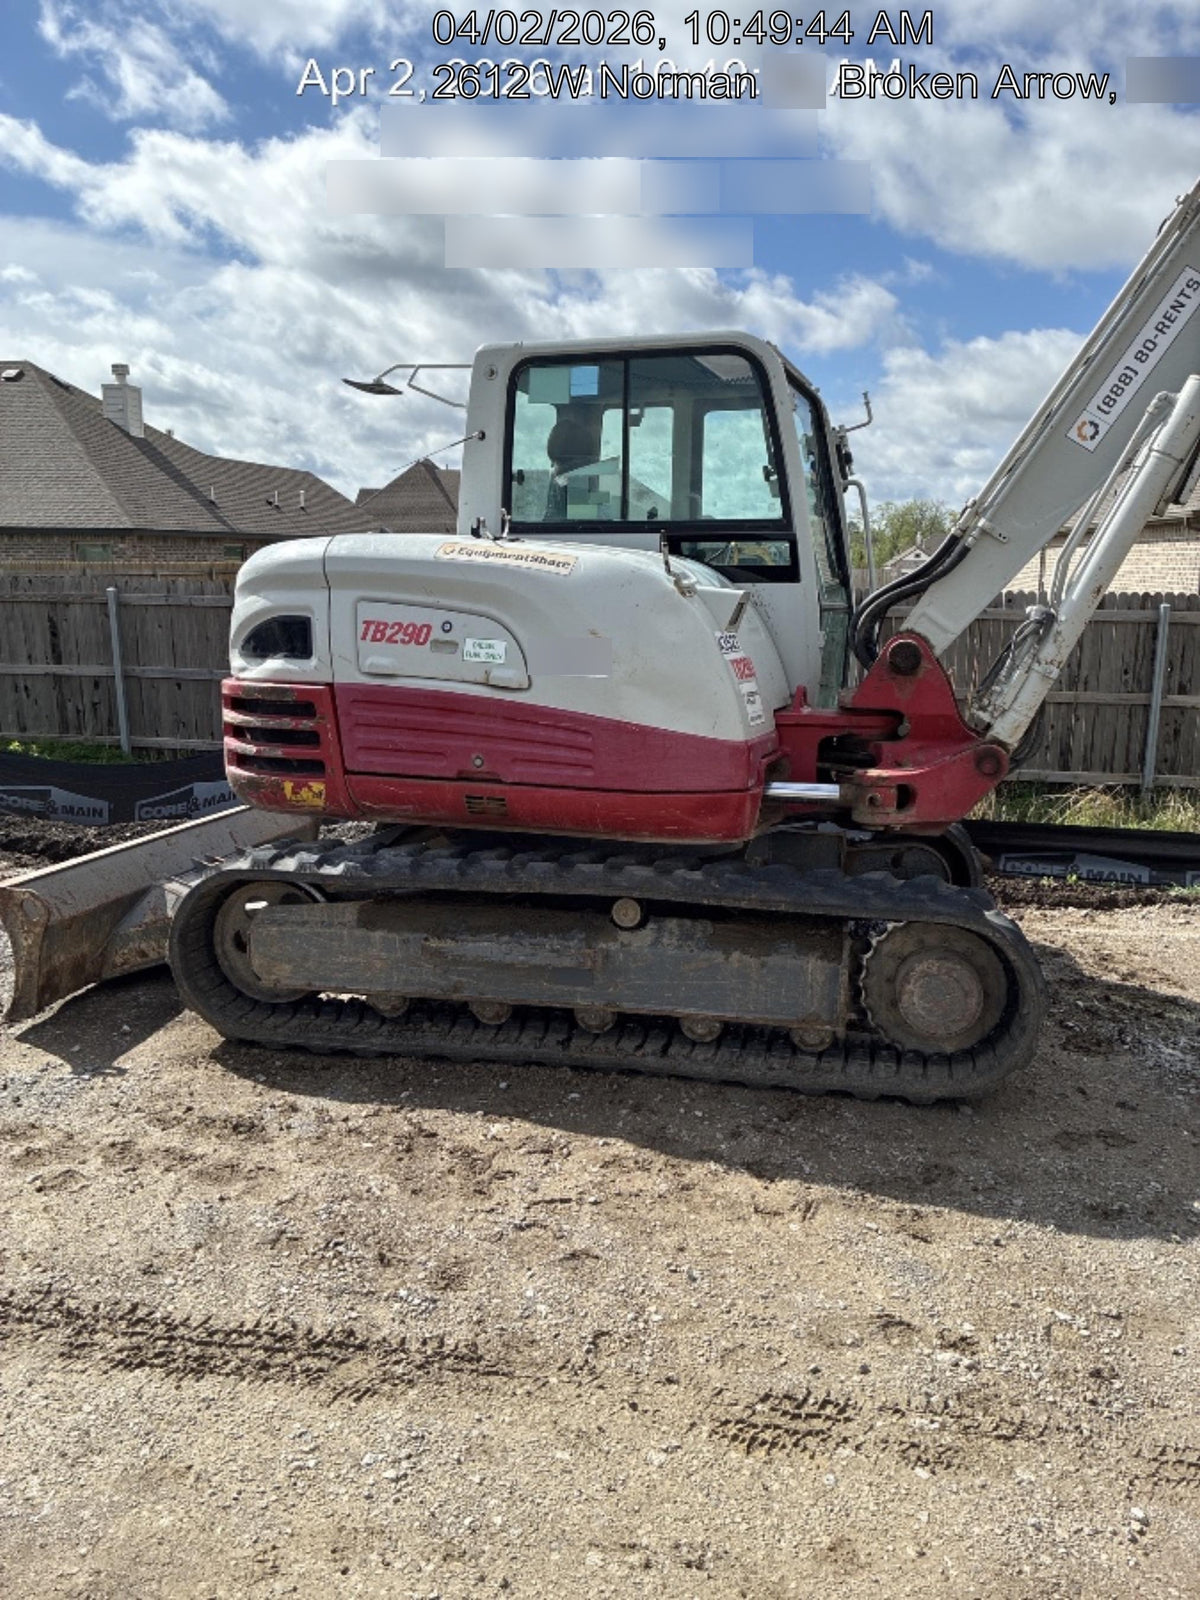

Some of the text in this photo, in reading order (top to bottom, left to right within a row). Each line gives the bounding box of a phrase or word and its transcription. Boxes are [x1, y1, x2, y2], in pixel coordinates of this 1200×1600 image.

[1097, 277, 1200, 415] (888) 80-RENTS
[360, 619, 433, 646] TB290
